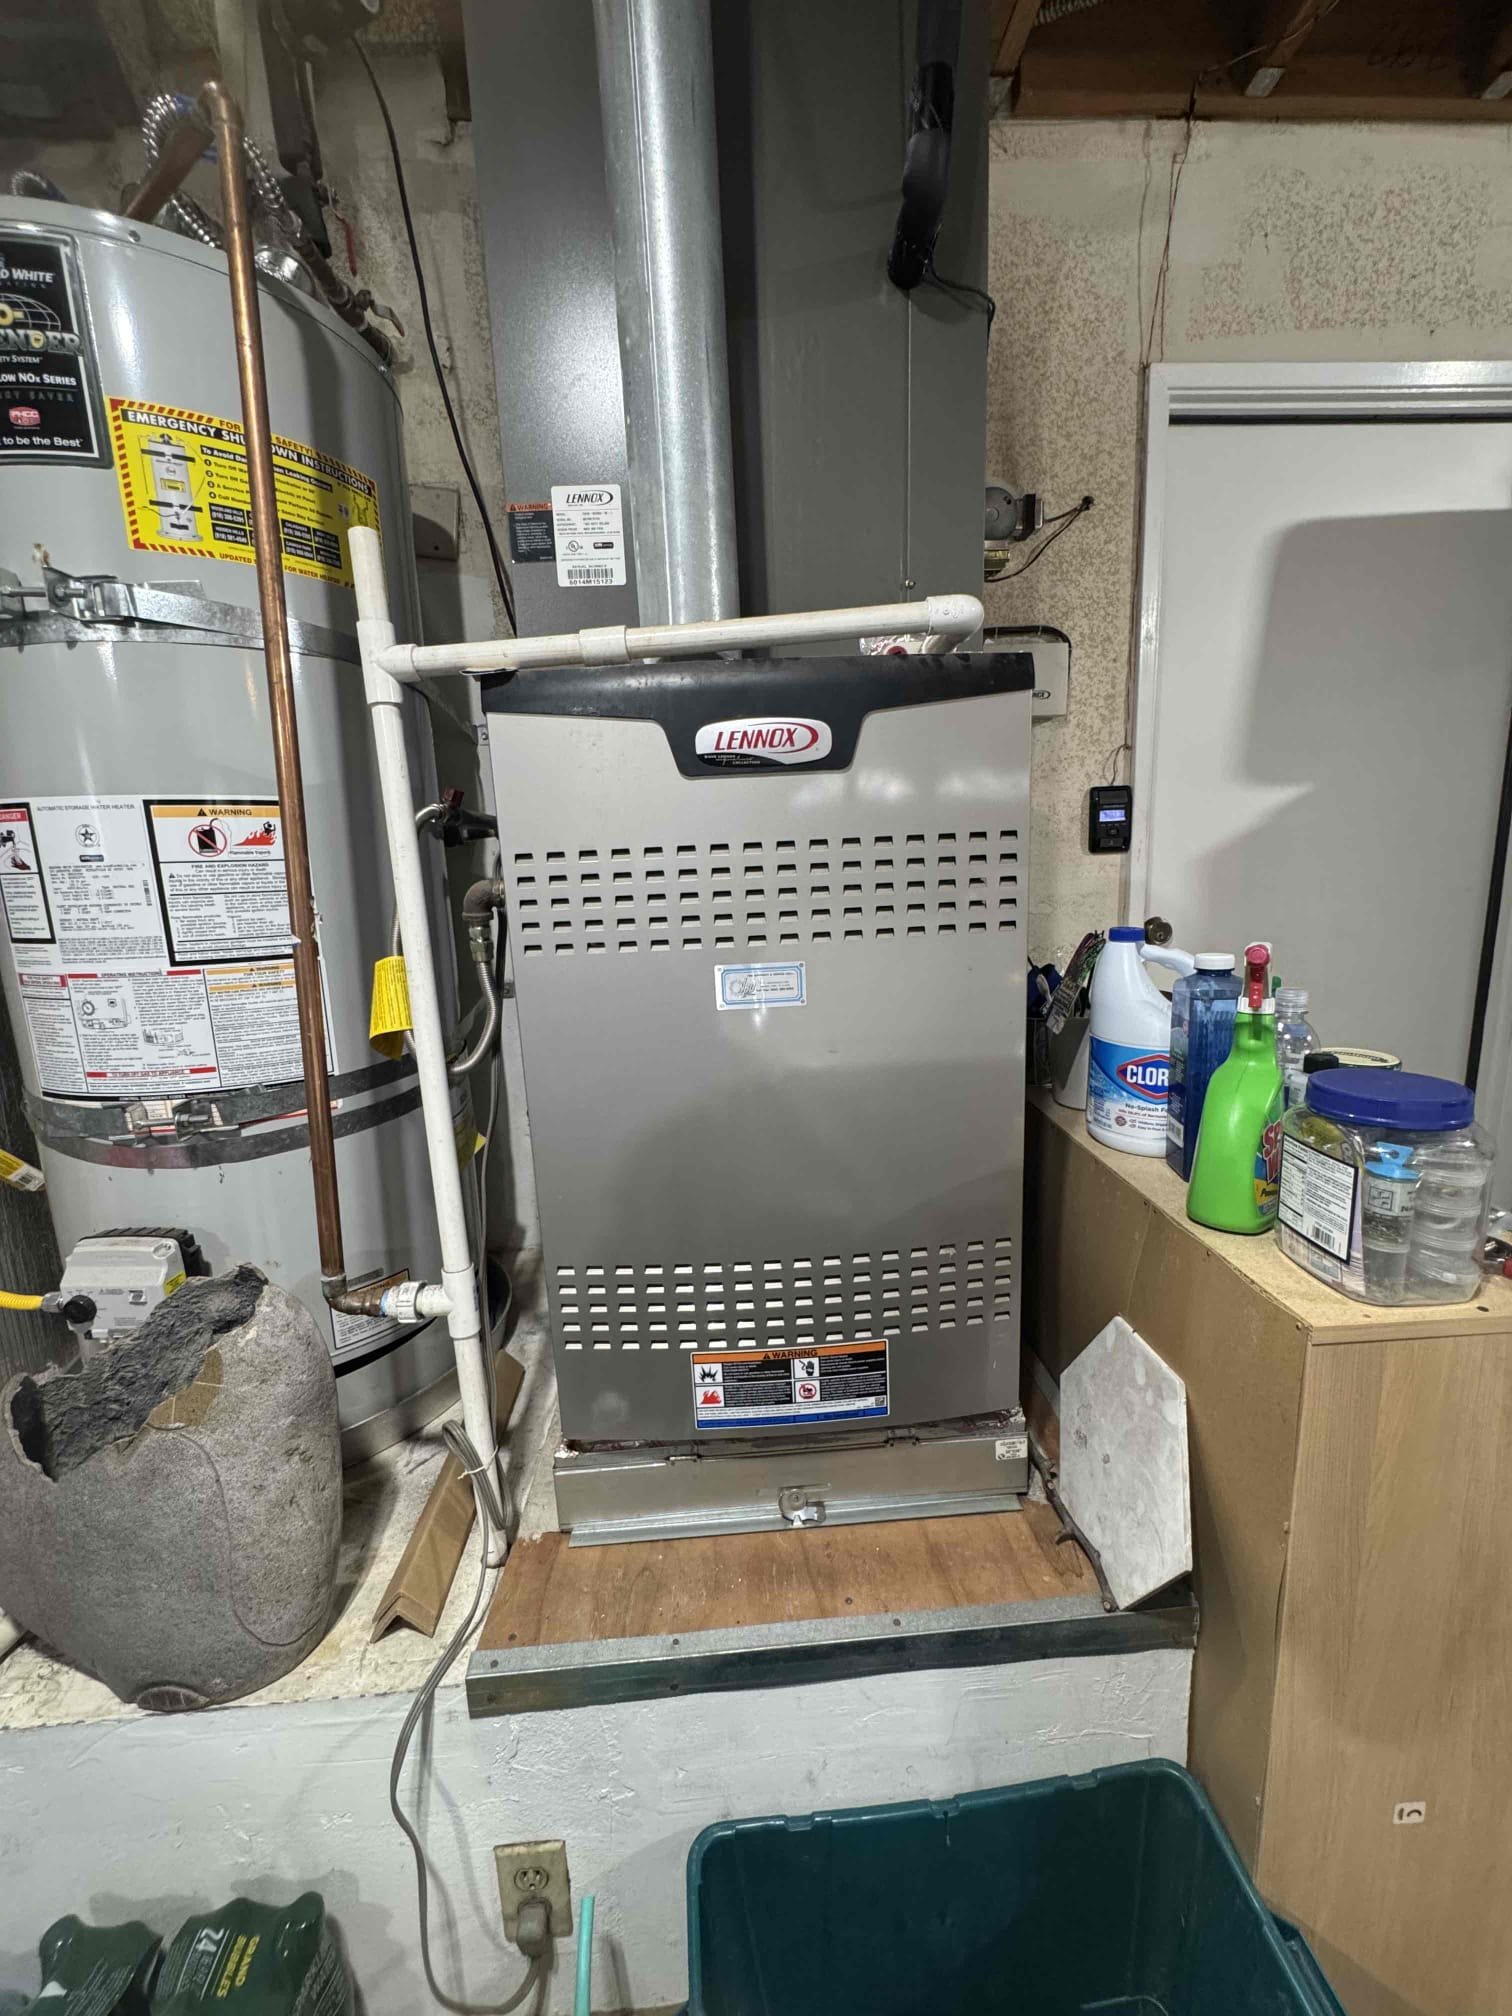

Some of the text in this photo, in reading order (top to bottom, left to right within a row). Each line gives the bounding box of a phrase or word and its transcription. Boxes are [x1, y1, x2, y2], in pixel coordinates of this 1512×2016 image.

[12, 268, 54, 283] WHITE
[42, 374, 77, 386] SERIES
[219, 420, 241, 432] FOR
[3, 436, 14, 444] to
[16, 436, 30, 445] be
[32, 436, 51, 446] the
[128, 411, 216, 437] EMERGENCY
[301, 456, 369, 493] INSTRUCTIONS
[566, 493, 604, 504] LENNOX
[220, 553, 252, 564] UPDATED
[714, 727, 798, 751] LENNOX
[1125, 1103, 1158, 1112] No-Splash
[772, 1350, 818, 1359] WARNING
[196, 1928, 224, 1952] 24
